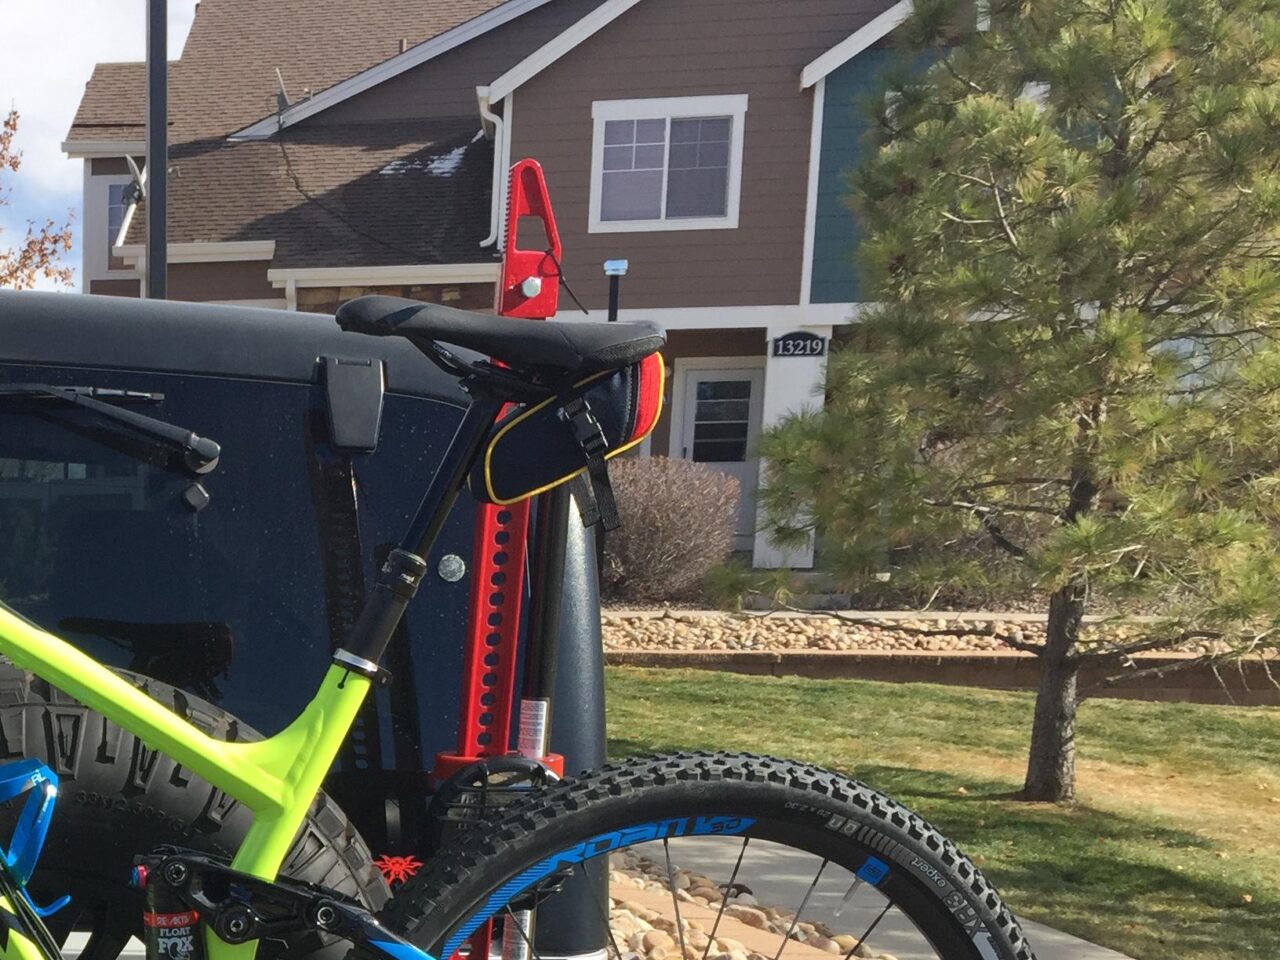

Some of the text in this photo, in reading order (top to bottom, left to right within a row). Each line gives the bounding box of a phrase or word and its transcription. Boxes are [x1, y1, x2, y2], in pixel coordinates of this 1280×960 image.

[776, 339, 822, 355] 13219
[910, 857, 947, 888] expert
[943, 891, 988, 940] XR3
[160, 926, 191, 937] FLOAT
[157, 936, 194, 959] FOX
